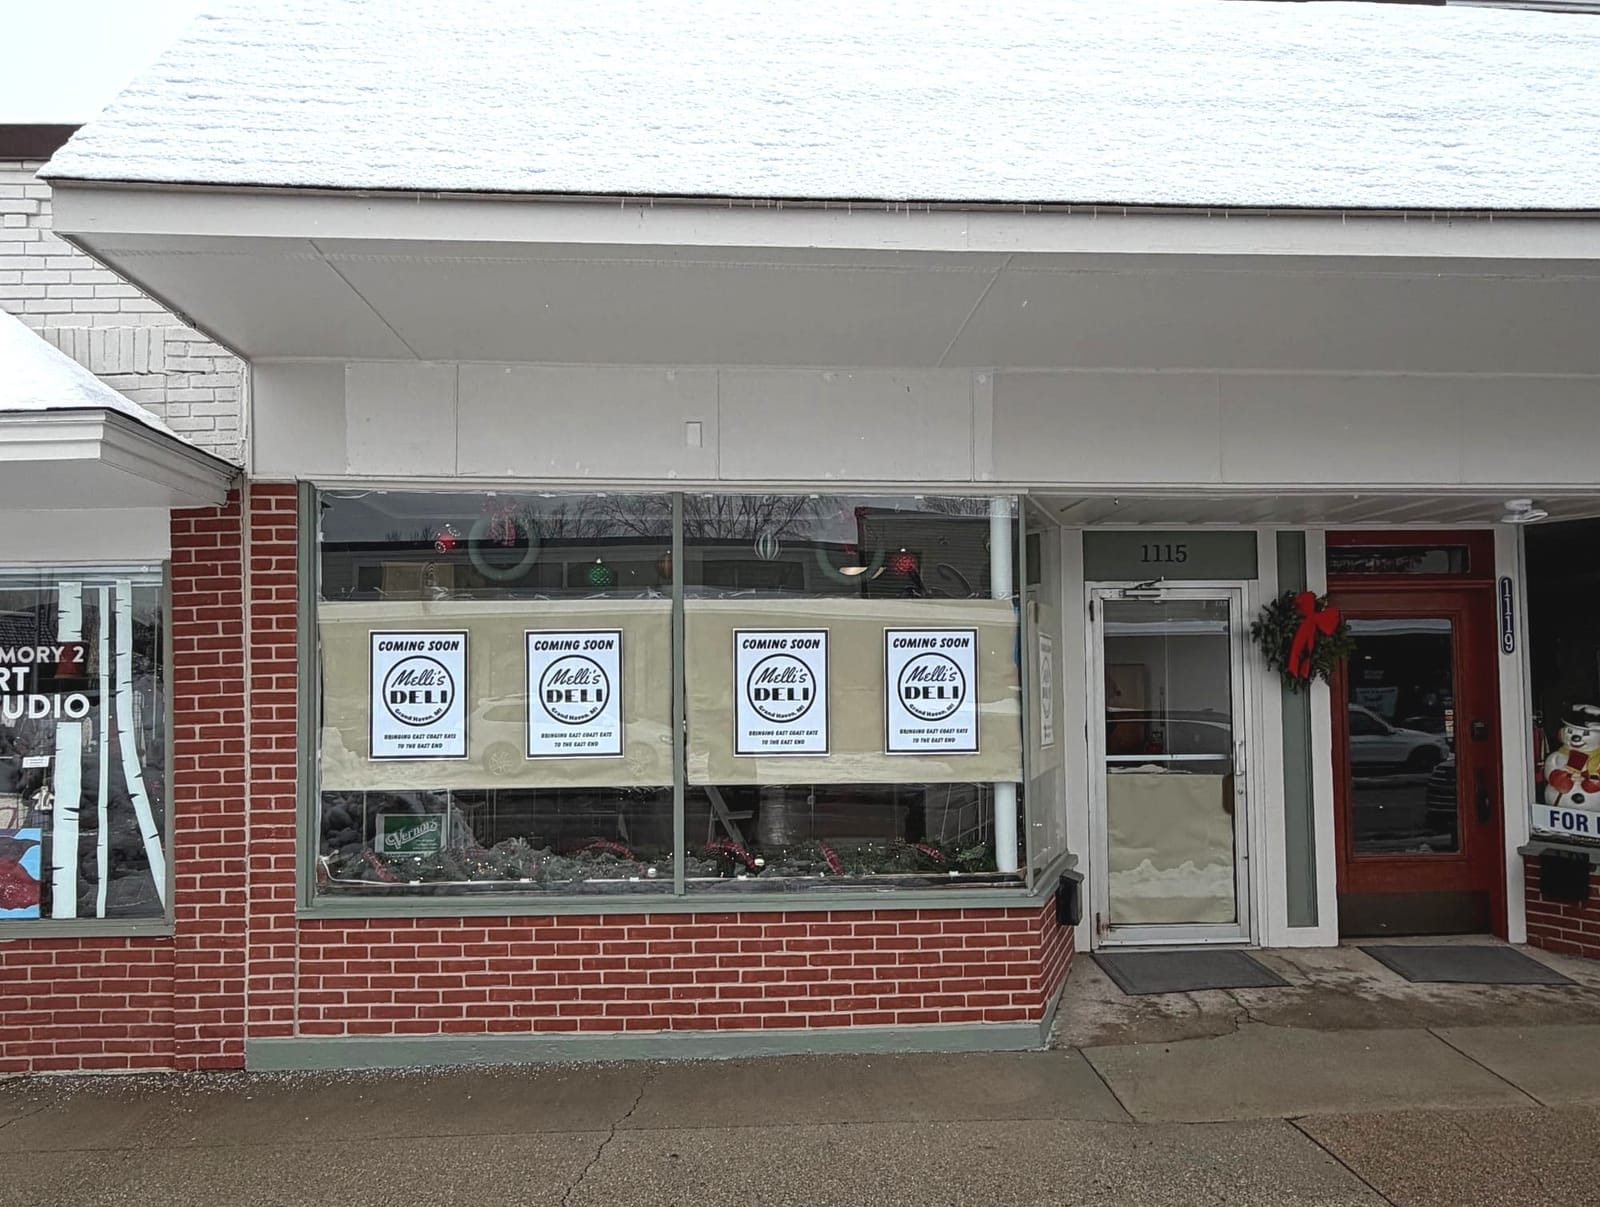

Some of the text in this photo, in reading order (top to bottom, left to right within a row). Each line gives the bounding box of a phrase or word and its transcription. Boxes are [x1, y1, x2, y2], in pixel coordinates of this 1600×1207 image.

[1141, 544, 1187, 562] 1115
[1503, 580, 1513, 651] 1119
[378, 640, 460, 652] COMING SOON
[534, 640, 614, 651] COMING SOON
[743, 639, 820, 649] COMING SOON
[893, 638, 970, 648] COMING SOON
[0, 646, 84, 663] MORY 2
[392, 669, 446, 688] Melli's
[547, 668, 601, 687] Melli's
[755, 666, 808, 686] Melli's
[905, 665, 958, 684] Melli's
[390, 690, 447, 704] DELI
[546, 689, 602, 703] DELI
[754, 687, 809, 701] DELI
[904, 686, 959, 700] DELI
[394, 708, 412, 721] Grand
[551, 707, 568, 720] Grand
[759, 705, 775, 718] Grand
[909, 704, 926, 716] Grand
[1550, 810, 1589, 832] FOR
